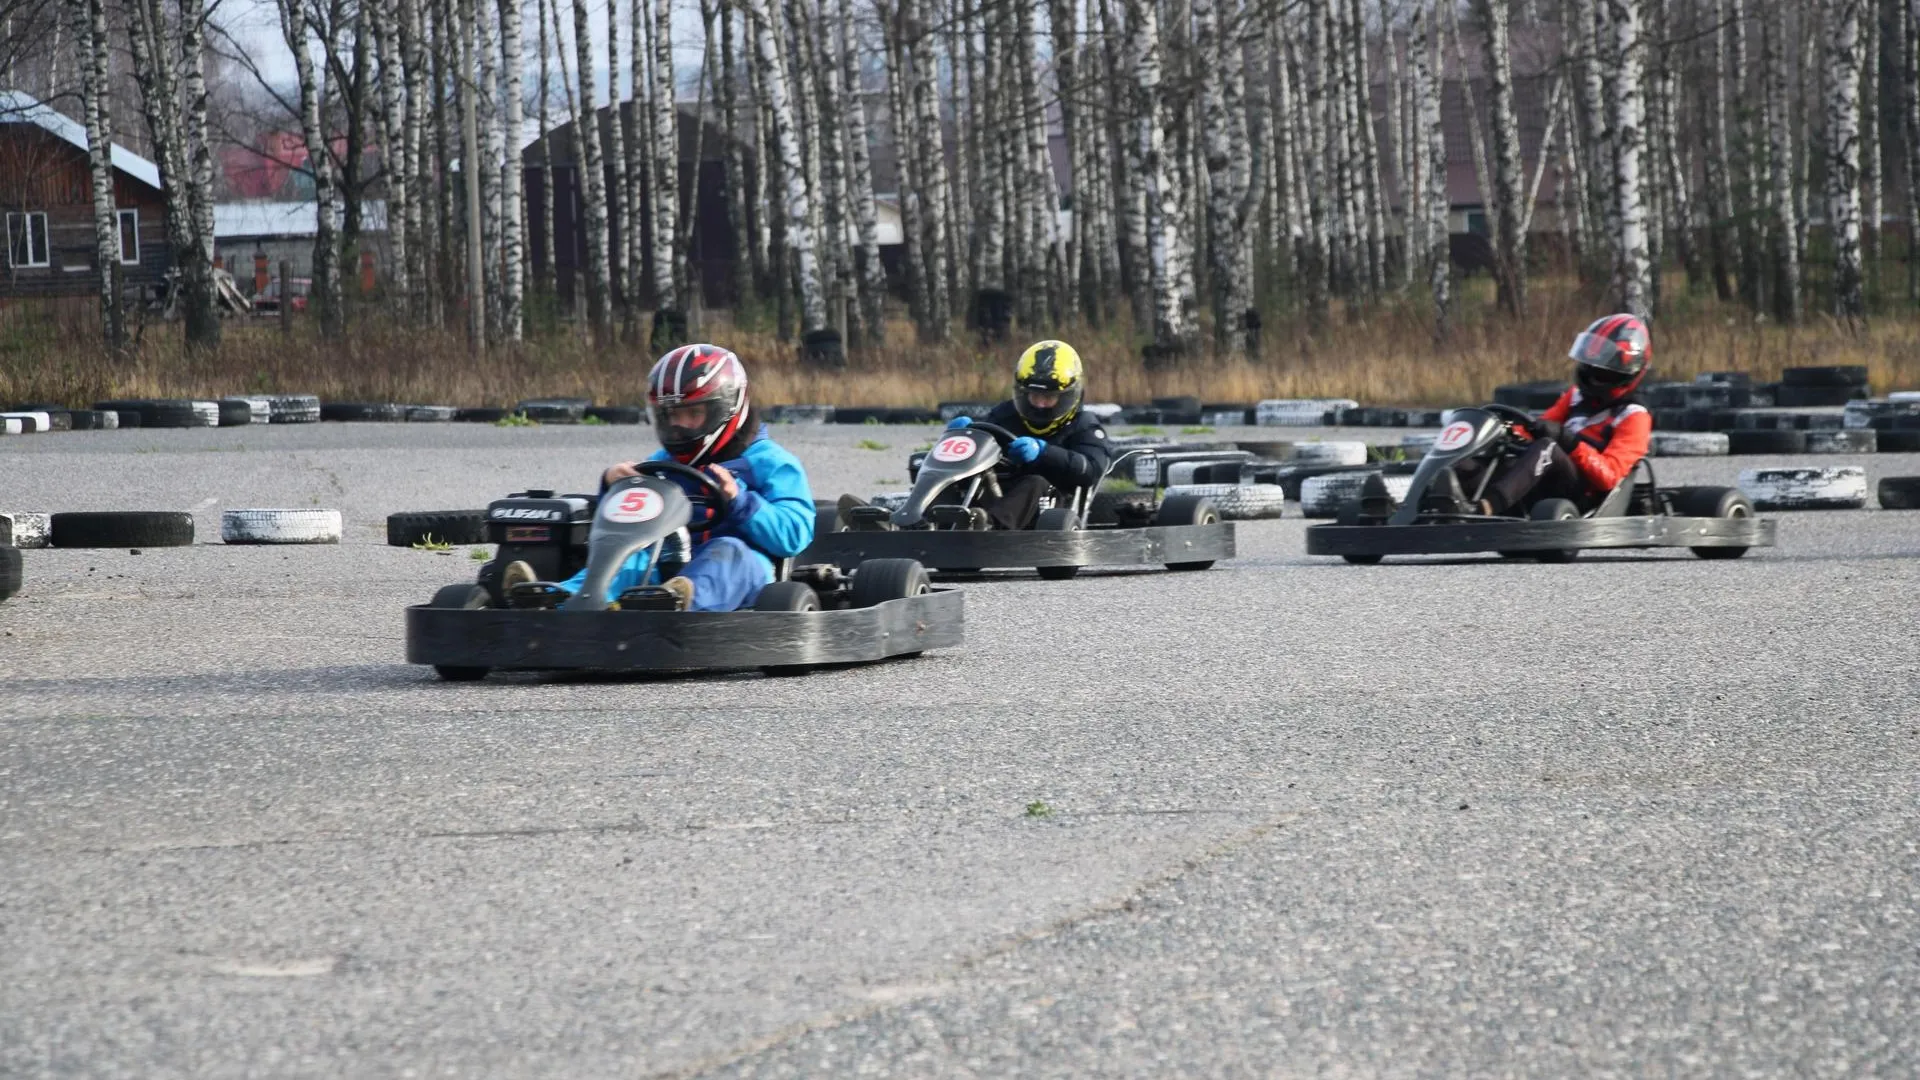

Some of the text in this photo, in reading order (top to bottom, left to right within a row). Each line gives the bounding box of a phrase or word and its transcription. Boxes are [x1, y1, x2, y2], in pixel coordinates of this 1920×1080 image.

[1443, 427, 1470, 441] 17
[942, 440, 970, 454] 16
[619, 492, 649, 512] 5
